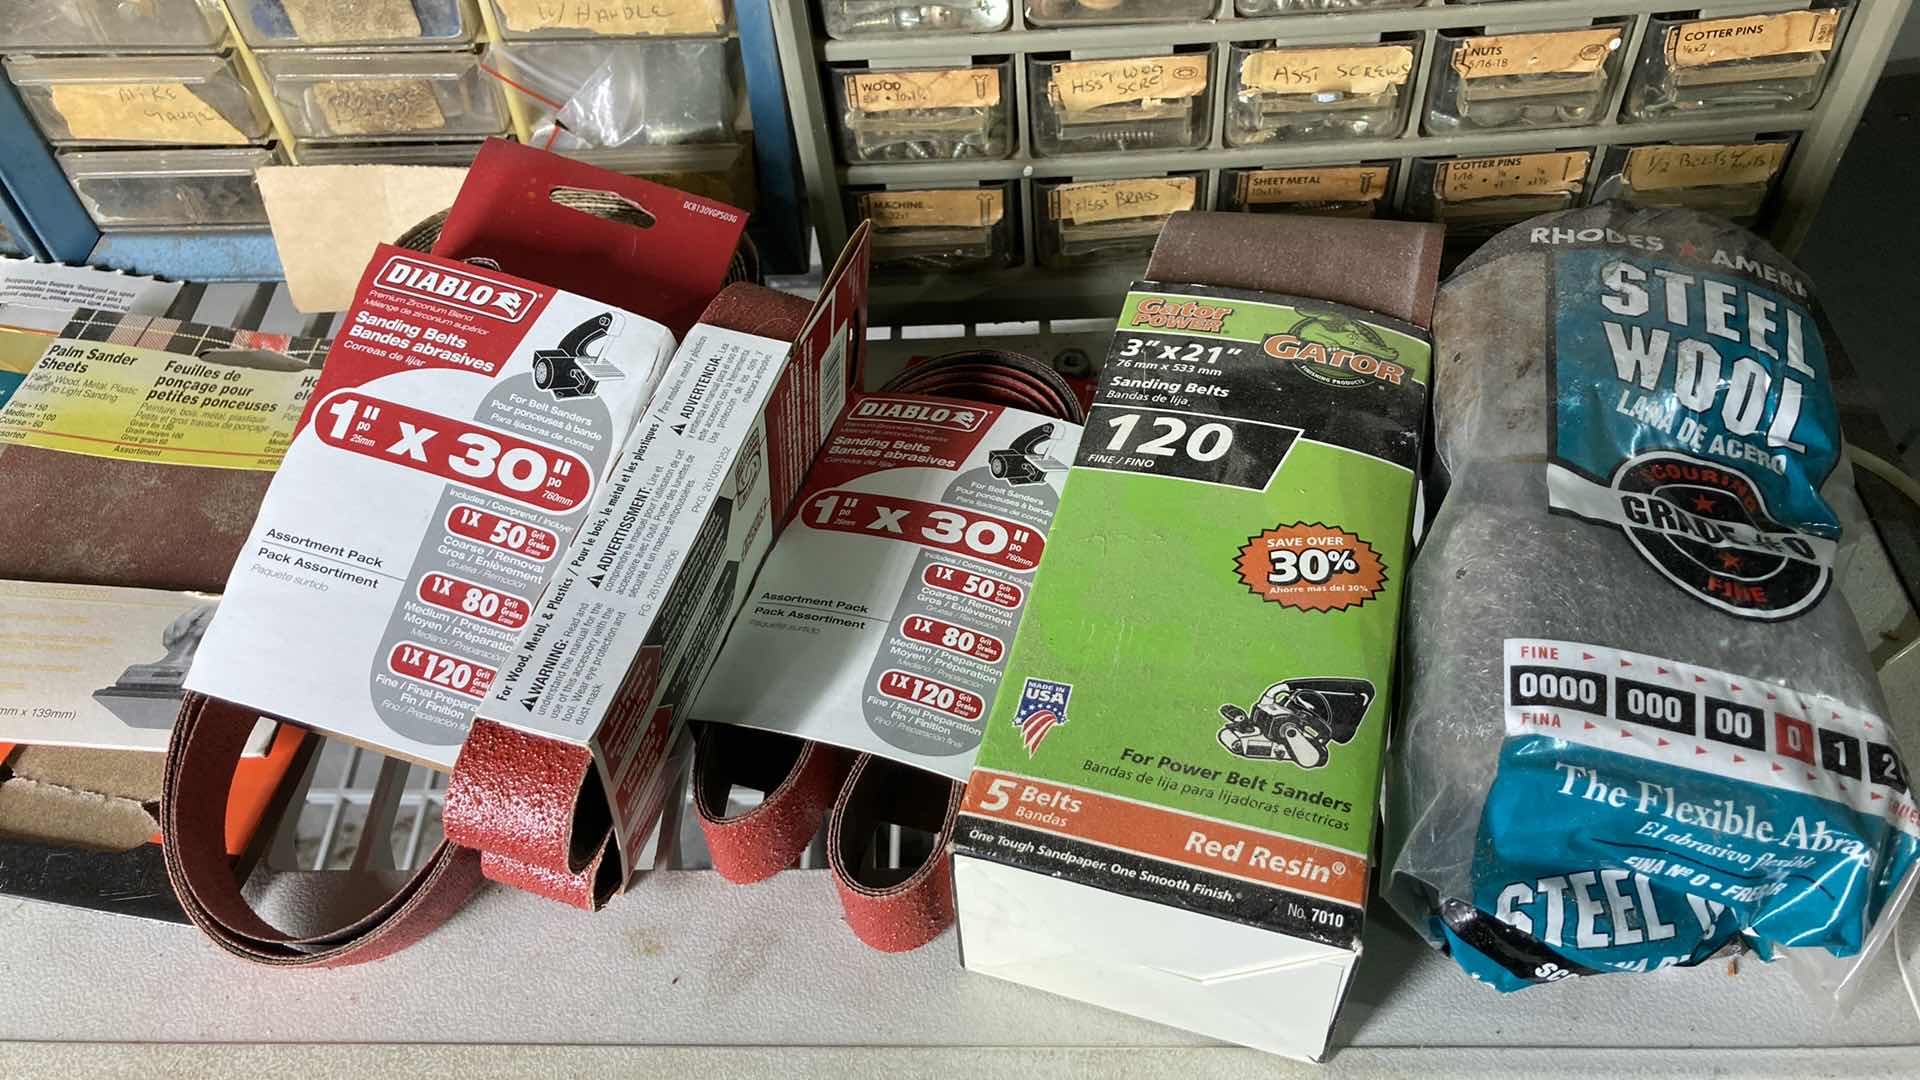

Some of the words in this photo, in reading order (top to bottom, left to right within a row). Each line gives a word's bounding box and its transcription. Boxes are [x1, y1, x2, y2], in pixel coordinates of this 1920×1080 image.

[1684, 28, 1733, 42] COTTER
[1735, 25, 1764, 37] PINS
[1470, 46, 1503, 56] NUTS
[1336, 64, 1410, 79] SCREWS
[862, 81, 901, 92] WOOD
[1452, 160, 1496, 170] COTTER
[1498, 158, 1521, 168] PINS
[1253, 177, 1285, 186] SHEET
[1287, 176, 1321, 185] METAL
[1530, 226, 1665, 252] RHODES
[386, 263, 494, 305] DIABLO
[1137, 297, 1234, 322] Gator
[1600, 260, 1816, 380] STEEL
[355, 310, 422, 339] Sanding
[422, 327, 468, 350] Belts
[1131, 312, 1226, 334] POWER
[48, 345, 85, 360] Palm
[86, 348, 138, 366] Sander
[342, 339, 388, 358] Correas
[388, 351, 403, 361] de
[406, 354, 427, 368] lijar
[348, 325, 411, 350] Bandes
[411, 343, 496, 373] abrasives
[1263, 334, 1405, 385] GATOR
[39, 358, 89, 374] Sheets
[164, 360, 220, 381] Feuilles
[223, 371, 242, 382] de
[1115, 358, 1132, 370] 76
[1134, 361, 1158, 371] mm
[1171, 362, 1197, 375] 533
[1200, 366, 1222, 377] mm
[1300, 365, 1330, 384] FINISHING
[1331, 377, 1366, 386] PRODUCTS
[153, 374, 218, 394] ponçage
[218, 387, 255, 398] pour
[680, 353, 724, 419] ADVERTENCIA:
[1106, 390, 1149, 403] Bandas
[1150, 393, 1168, 404] de
[1110, 376, 1181, 398] Sanding
[1185, 382, 1230, 399] Belts
[1601, 319, 1807, 455] WOOL
[145, 389, 201, 406] petites
[200, 398, 279, 413] ponceuses
[509, 393, 527, 405] For
[527, 399, 549, 412] Belt
[550, 406, 593, 426] Sanders
[859, 402, 950, 423] DIABLO
[328, 398, 381, 440] 1"
[386, 422, 439, 463] X
[448, 432, 572, 492] 30"
[833, 435, 890, 451] Sanding
[891, 440, 931, 454] Belts
[1105, 413, 1234, 463] 120
[1615, 388, 1675, 435] LANA
[1675, 415, 1710, 451] DE
[1706, 434, 1789, 476] ACERO
[113, 445, 162, 457] Assortiment
[828, 445, 882, 459] Bandes
[883, 450, 960, 468] abrasives
[1087, 452, 1118, 465] FINE
[1125, 457, 1155, 469] FINO
[541, 489, 574, 507] 760mm
[460, 508, 482, 528] 1X
[489, 514, 527, 549] 50
[813, 496, 860, 524] 1"
[866, 506, 912, 534] X
[921, 511, 1031, 555] 30"
[266, 528, 345, 557] Assortment
[347, 550, 384, 568] Pack
[442, 535, 488, 557] Coarse
[494, 546, 546, 573] Removal
[1266, 537, 1303, 548] SAVE
[1306, 536, 1345, 547] OVER
[257, 546, 292, 566] Pack
[294, 557, 380, 589] Assortiment
[496, 683, 514, 702] For
[509, 648, 535, 682] Wood,
[527, 624, 549, 652] Metal,
[548, 575, 575, 611] Plastics
[591, 514, 610, 540] bois,
[633, 423, 661, 462] plastiques
[1267, 548, 1358, 584] 30%
[430, 576, 454, 597] 1X
[461, 587, 499, 618] 80
[1269, 585, 1305, 595] Ahorre
[1329, 584, 1346, 593] del
[1348, 584, 1369, 593] 30%
[1707, 576, 1769, 605] FINE
[761, 592, 834, 611] Assortment
[836, 600, 869, 614] Pack
[753, 606, 785, 619] Pack
[787, 610, 866, 631] Assortiment
[1519, 645, 1560, 661] FINE
[400, 647, 421, 667] 1X
[421, 655, 472, 691] 120
[528, 639, 570, 697] WARNING:
[1025, 689, 1065, 705] USA
[1028, 680, 1053, 692] MADE
[1055, 685, 1067, 694] IN
[31, 707, 78, 721] 139mm)
[1519, 672, 1598, 706] 0000
[1627, 688, 1682, 724] 000
[1714, 710, 1753, 740] 00
[1787, 725, 1801, 752] 0
[1834, 741, 1847, 767] 1
[1882, 753, 1898, 780] 2
[1520, 711, 1562, 731] FINA
[1119, 748, 1154, 768] For
[1156, 756, 1223, 783] Power
[1225, 770, 1268, 793] Belt
[1270, 782, 1354, 815] Sanders
[979, 779, 1019, 812] 5
[1018, 783, 1083, 814] Belts
[1082, 760, 1134, 785] Bandas
[1136, 772, 1154, 786] de
[1156, 775, 1179, 794] lija
[1179, 782, 1215, 802] para
[1217, 785, 1281, 814] lijadoras
[1283, 803, 1351, 834] eléctricas
[1554, 761, 1627, 809] The
[1635, 780, 1774, 844] Flexible
[1015, 806, 1069, 829] Bandas
[1184, 831, 1245, 863] Red
[1248, 848, 1347, 885] Resin®
[1635, 820, 1662, 838] El
[1665, 831, 1752, 872] abrasivo
[969, 829, 994, 844] One
[998, 834, 1035, 857] Tough
[1036, 845, 1108, 872] Sandpaper.
[1110, 863, 1137, 879] One
[1139, 869, 1191, 895] Smooth
[1287, 902, 1307, 920] No.
[1311, 908, 1344, 929] 7010
[1495, 868, 1676, 950] STEEL
